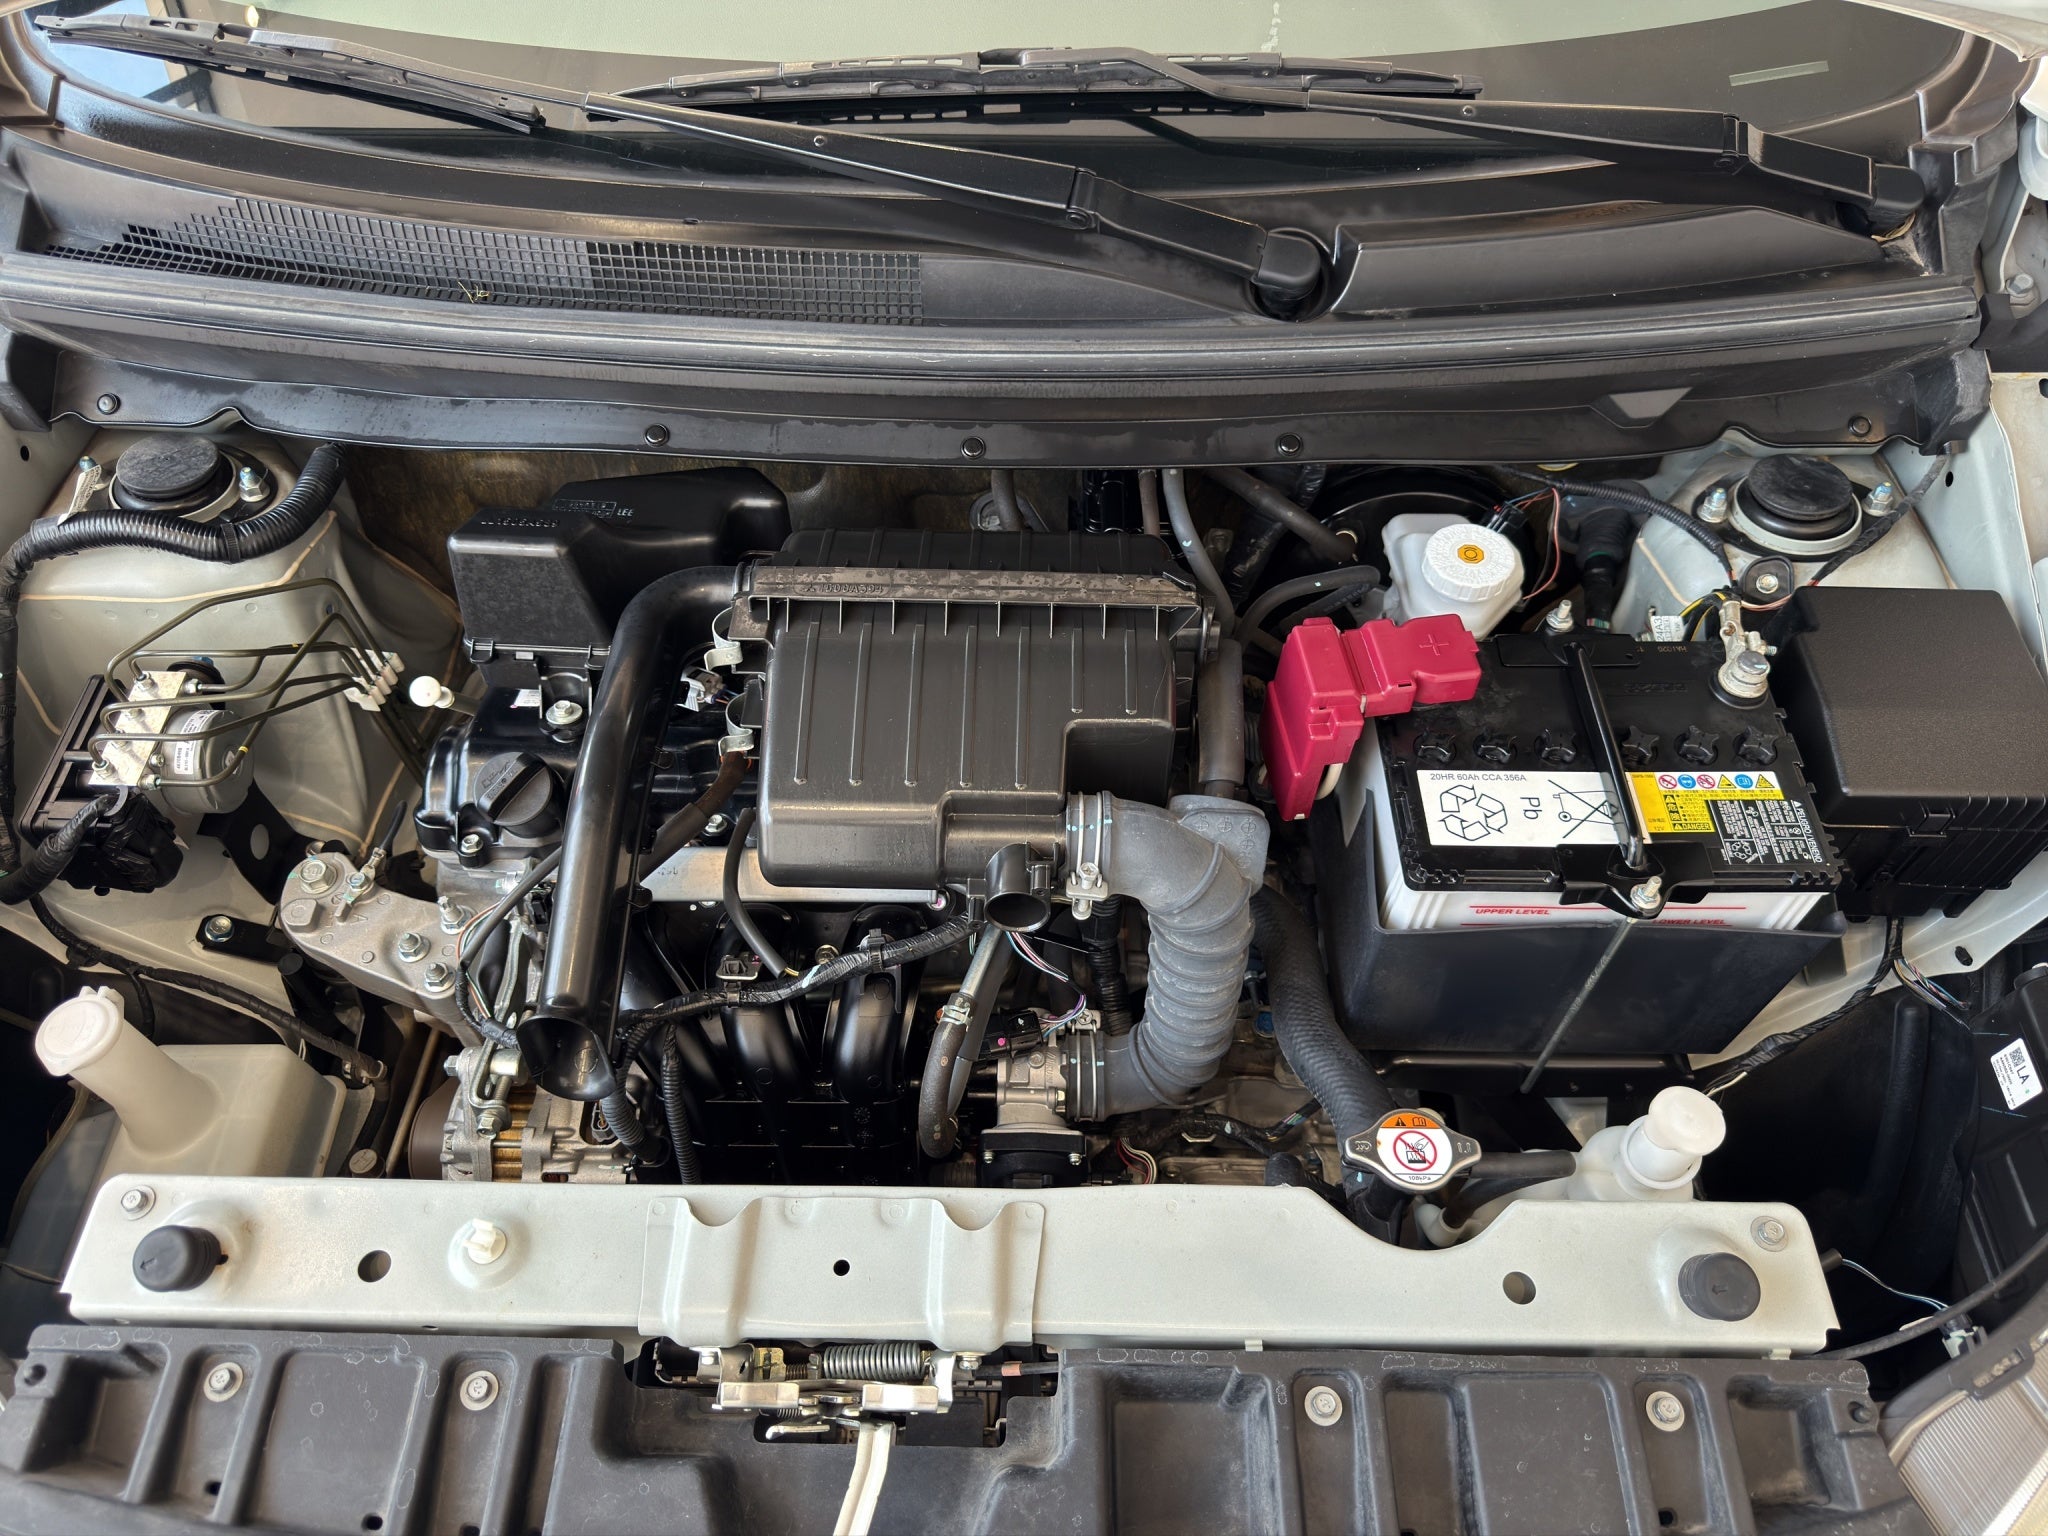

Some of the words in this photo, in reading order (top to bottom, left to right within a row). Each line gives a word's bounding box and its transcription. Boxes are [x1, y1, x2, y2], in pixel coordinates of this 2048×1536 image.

[1430, 773, 1454, 781] 20HR
[1457, 773, 1480, 781] 60Ah
[1482, 773, 1502, 781] CCA
[1503, 774, 1527, 782] 356A
[1520, 797, 1543, 819] Pb
[1681, 822, 1712, 831] DANGER
[1797, 807, 1812, 833] PELIGRO
[1807, 837, 1822, 863] VENENO
[1692, 918, 1726, 926] LEVEL
